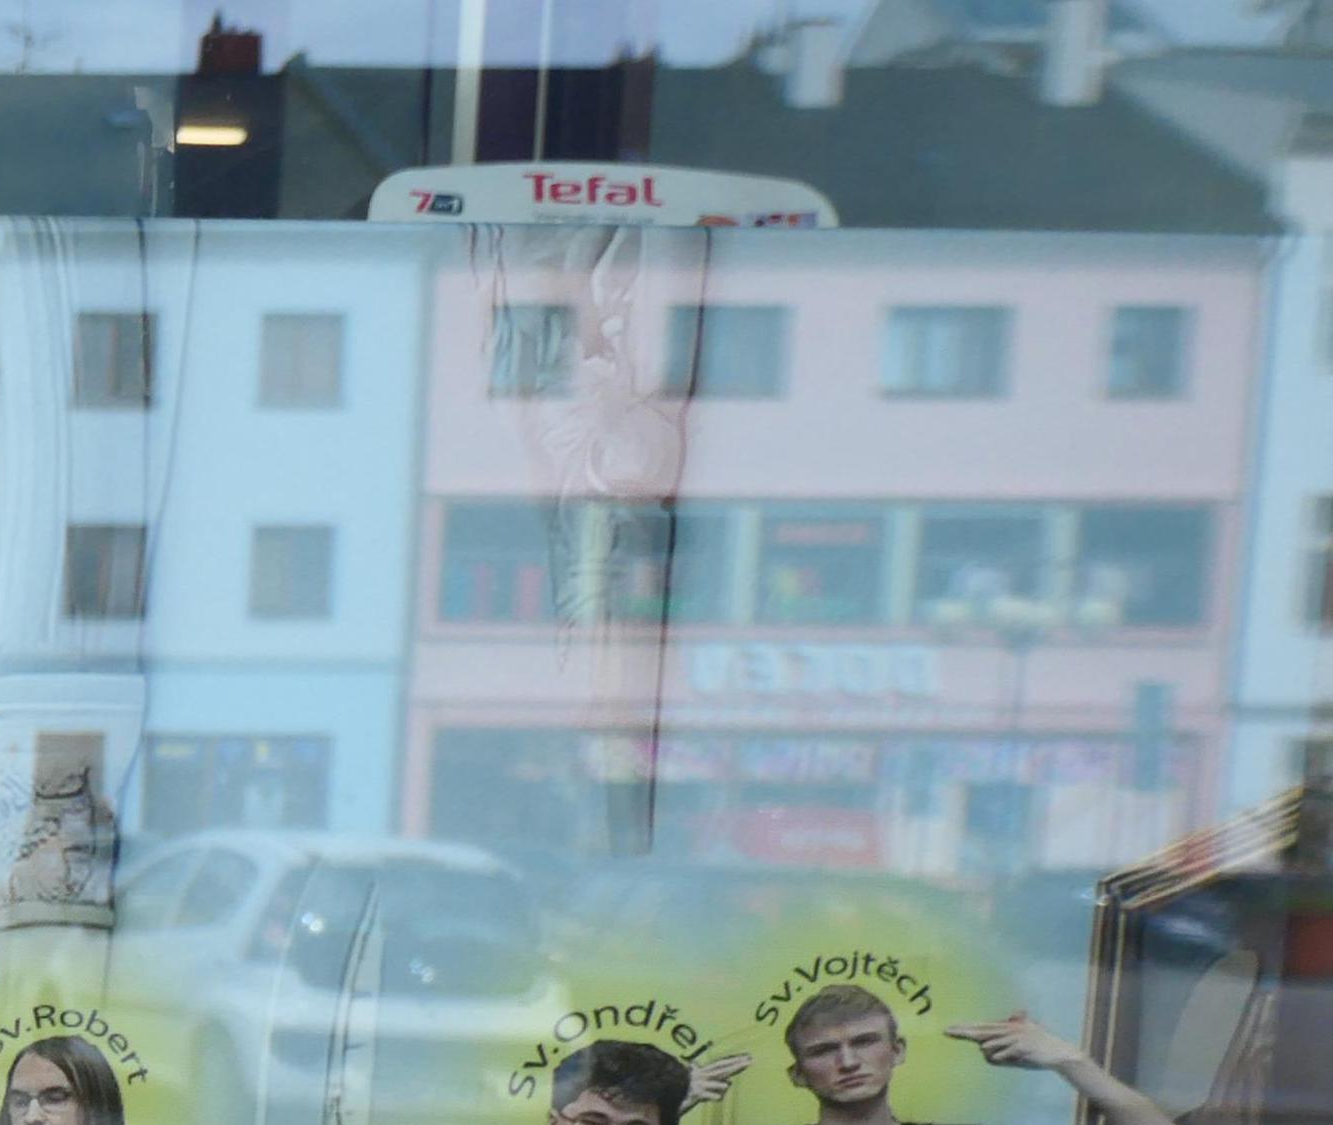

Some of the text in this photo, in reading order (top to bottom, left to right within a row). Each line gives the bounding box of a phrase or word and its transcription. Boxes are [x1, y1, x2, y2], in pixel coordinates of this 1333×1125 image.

[523, 172, 663, 208] Tefal
[756, 951, 934, 1027] Sv.Vojtěch
[508, 1000, 714, 1099] Sv.Ondřej
